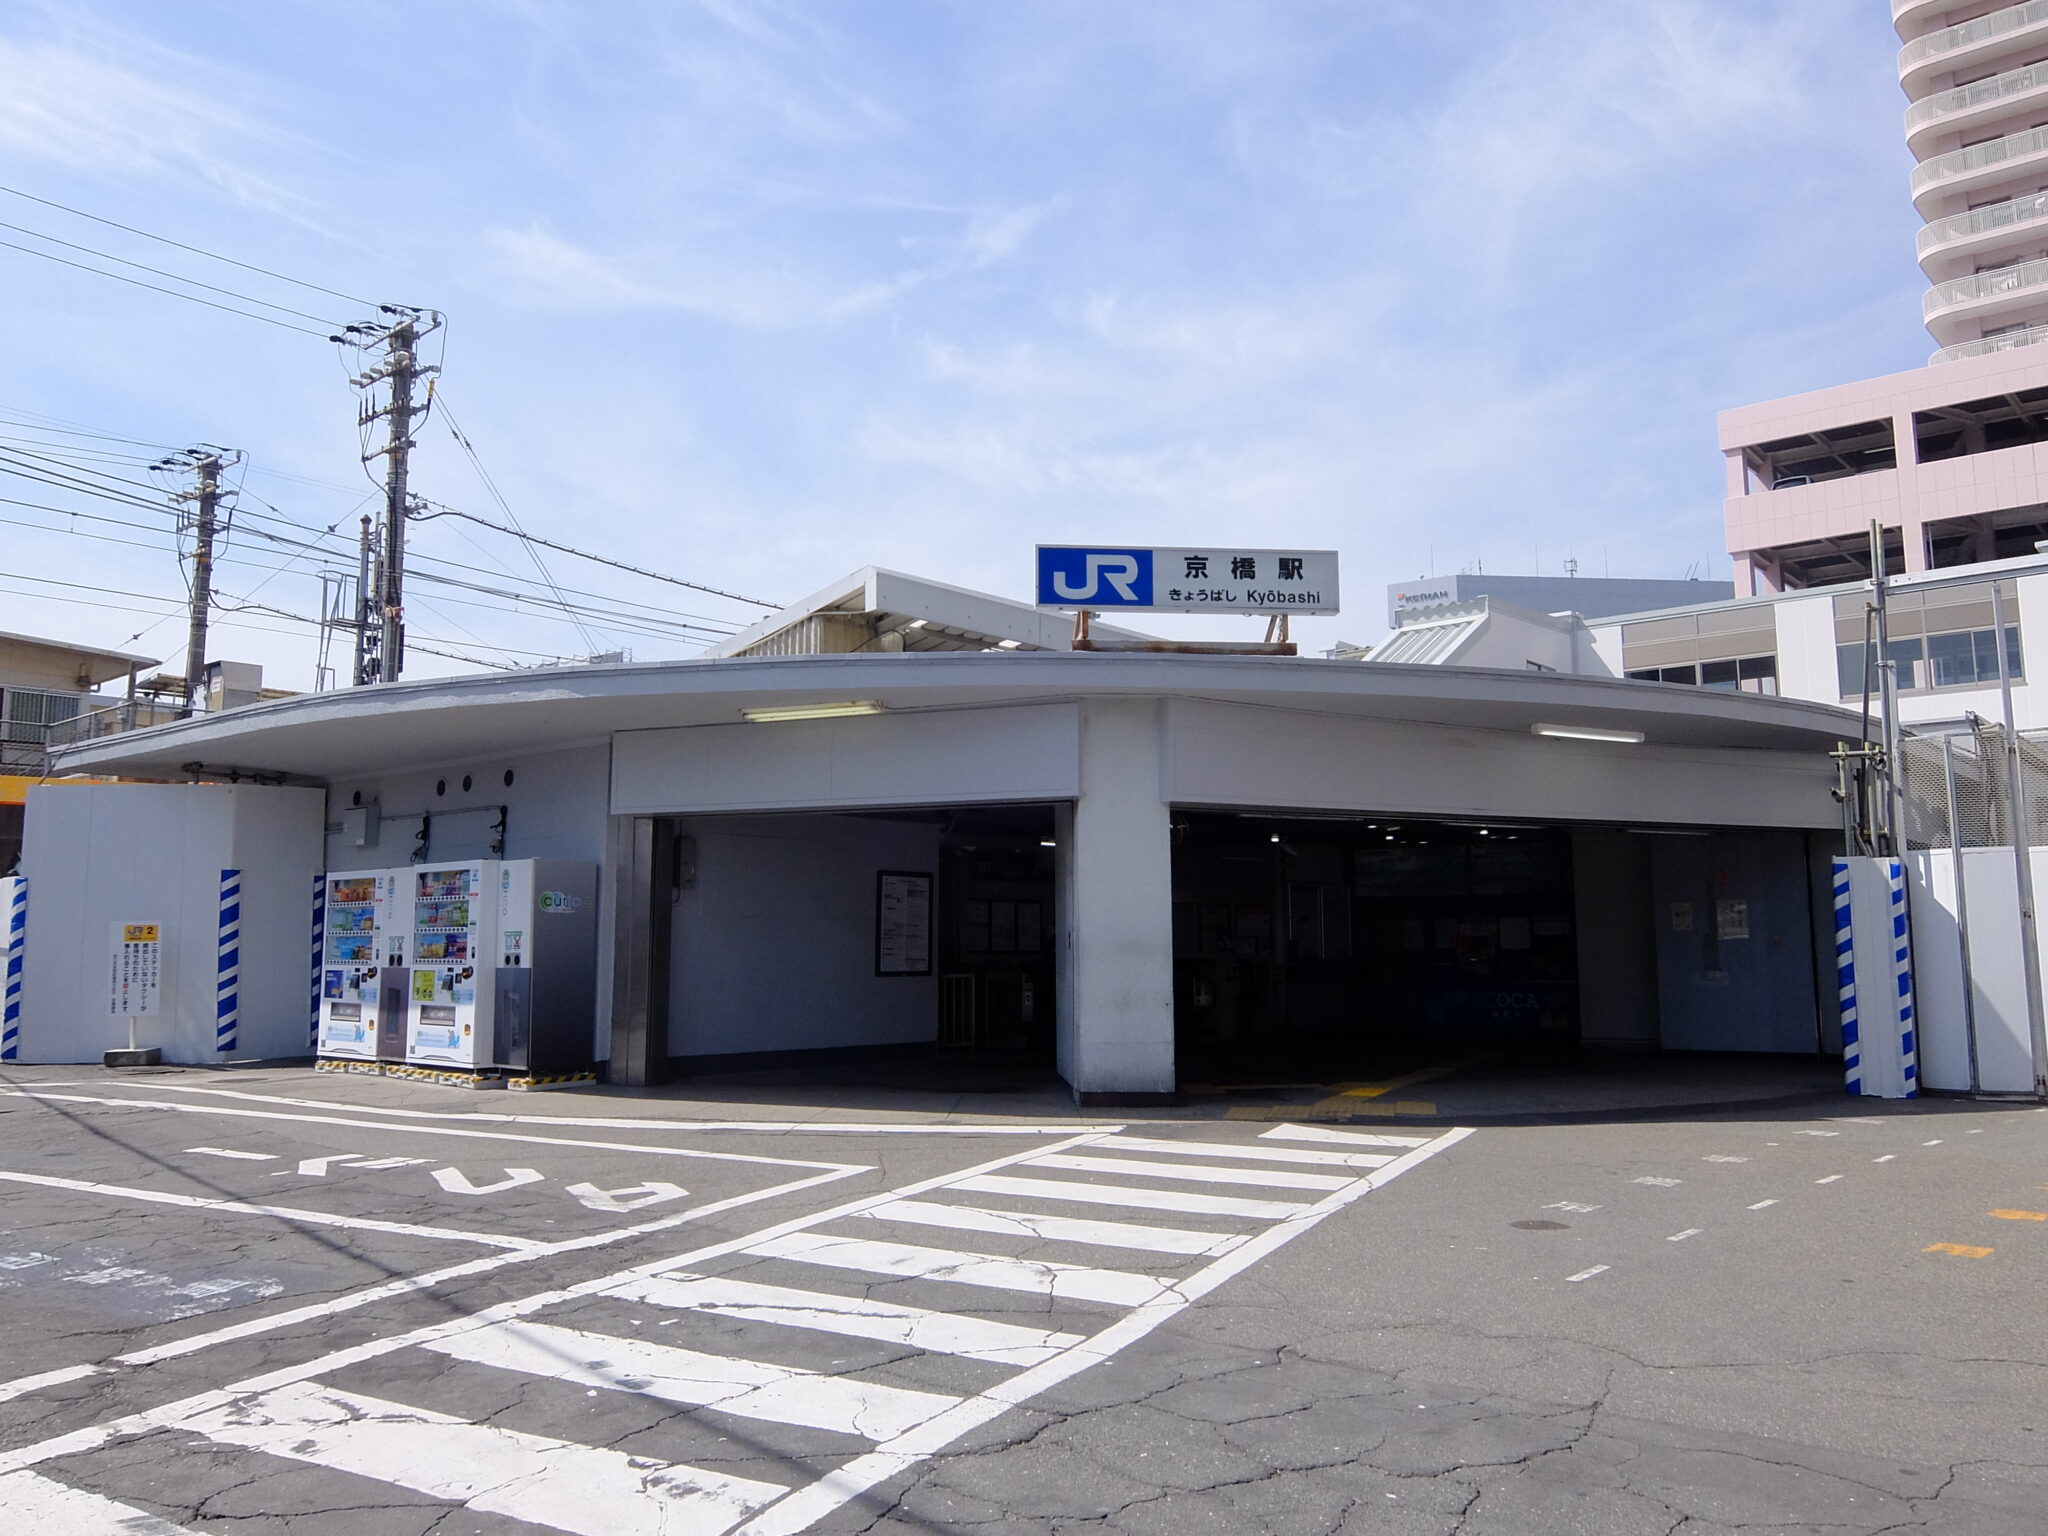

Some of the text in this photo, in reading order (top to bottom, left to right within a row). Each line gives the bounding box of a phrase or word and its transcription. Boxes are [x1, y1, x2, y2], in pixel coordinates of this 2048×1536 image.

[1053, 554, 1139, 601] JR
[1183, 555, 1304, 581] 京橋駅
[1168, 589, 1321, 606] きょうばし Kyōbashi
[146, 926, 154, 935] 2
